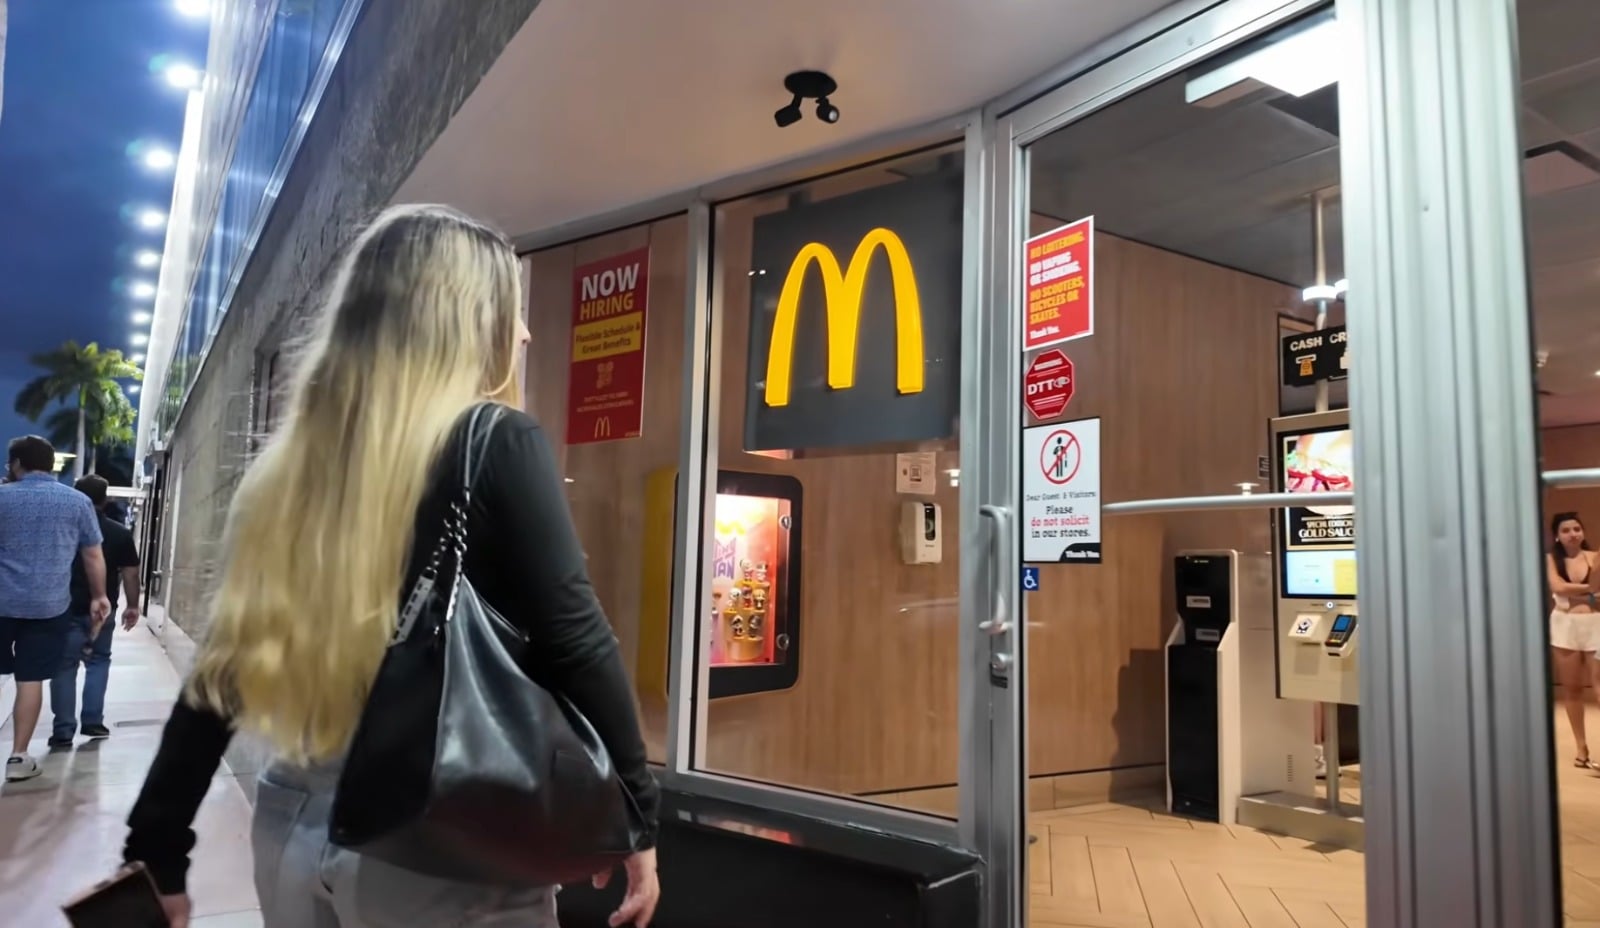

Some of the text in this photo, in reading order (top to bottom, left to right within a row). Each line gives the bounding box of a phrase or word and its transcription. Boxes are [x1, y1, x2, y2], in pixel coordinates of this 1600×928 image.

[581, 263, 640, 301] NOW
[579, 292, 634, 321] HIRING
[603, 324, 634, 338] Schedule
[603, 337, 631, 350] Benefits
[1290, 331, 1348, 351] CASH CR
[1046, 505, 1073, 514] Please
[1031, 515, 1089, 527] do not solicit
[1032, 528, 1091, 538] in our stores.
[1298, 527, 1354, 538] GOLD SAUC
